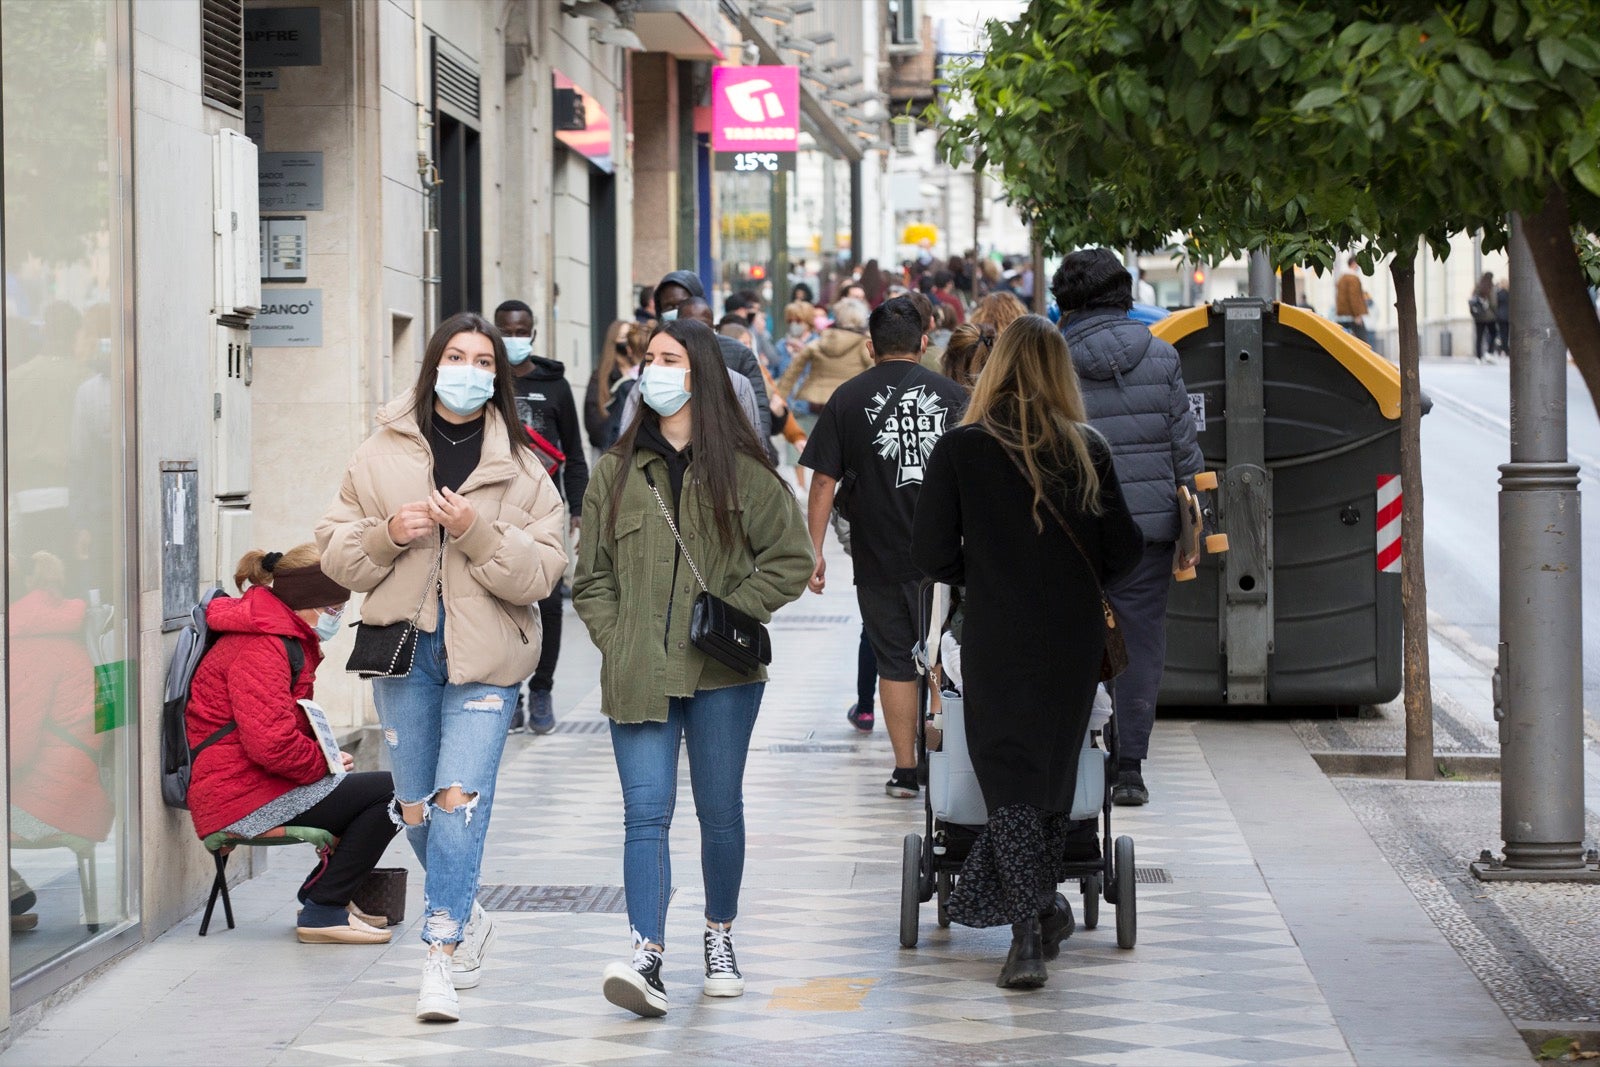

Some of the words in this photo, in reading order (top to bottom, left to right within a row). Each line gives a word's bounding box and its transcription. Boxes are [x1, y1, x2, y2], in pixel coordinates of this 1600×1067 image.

[723, 127, 796, 140] TABACOS
[260, 304, 310, 315] BANCO
[885, 416, 931, 433] DOG
